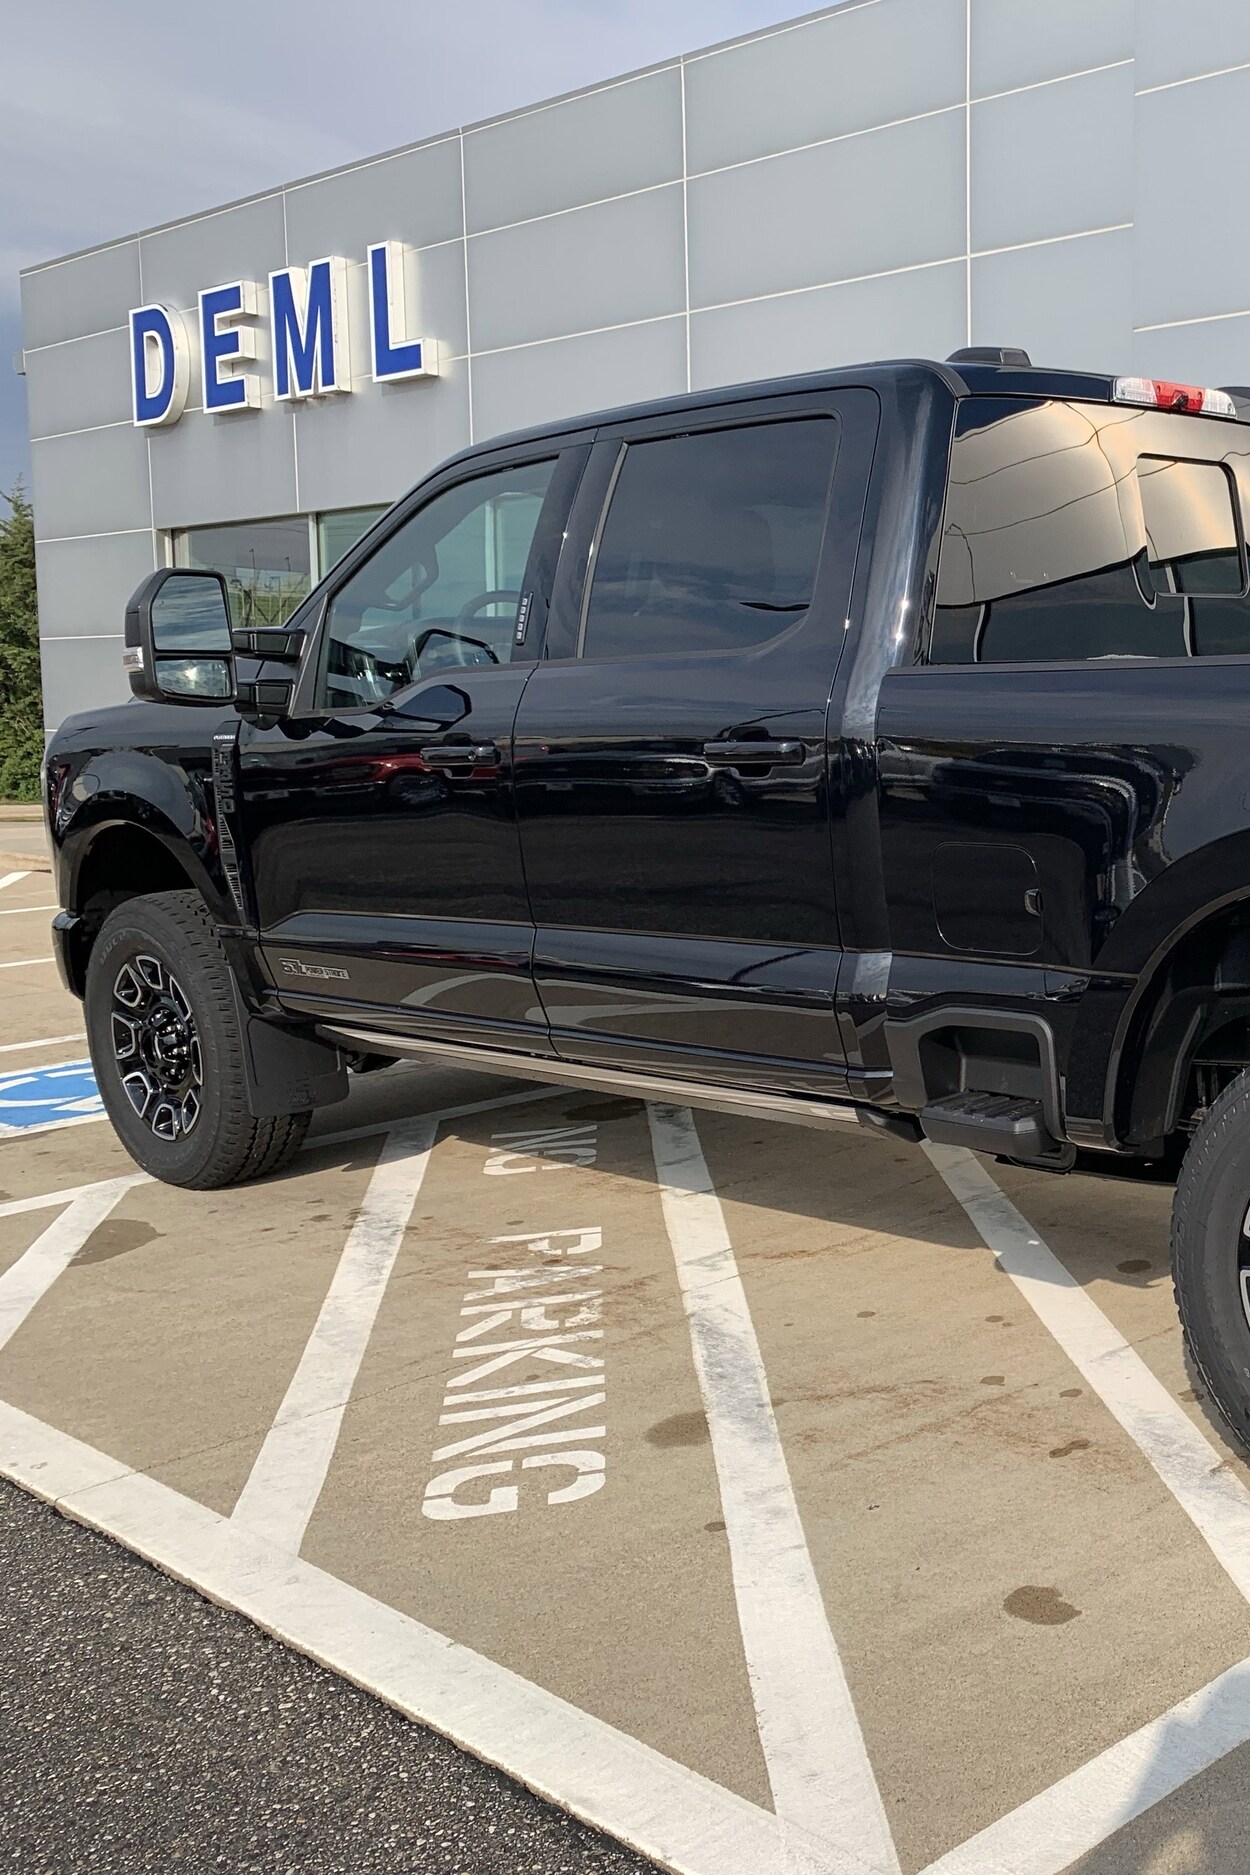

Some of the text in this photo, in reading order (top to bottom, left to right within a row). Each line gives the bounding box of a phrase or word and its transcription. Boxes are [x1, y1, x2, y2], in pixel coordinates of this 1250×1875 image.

[128, 240, 439, 427] DEML
[421, 1125, 606, 1521] NO PARKING
